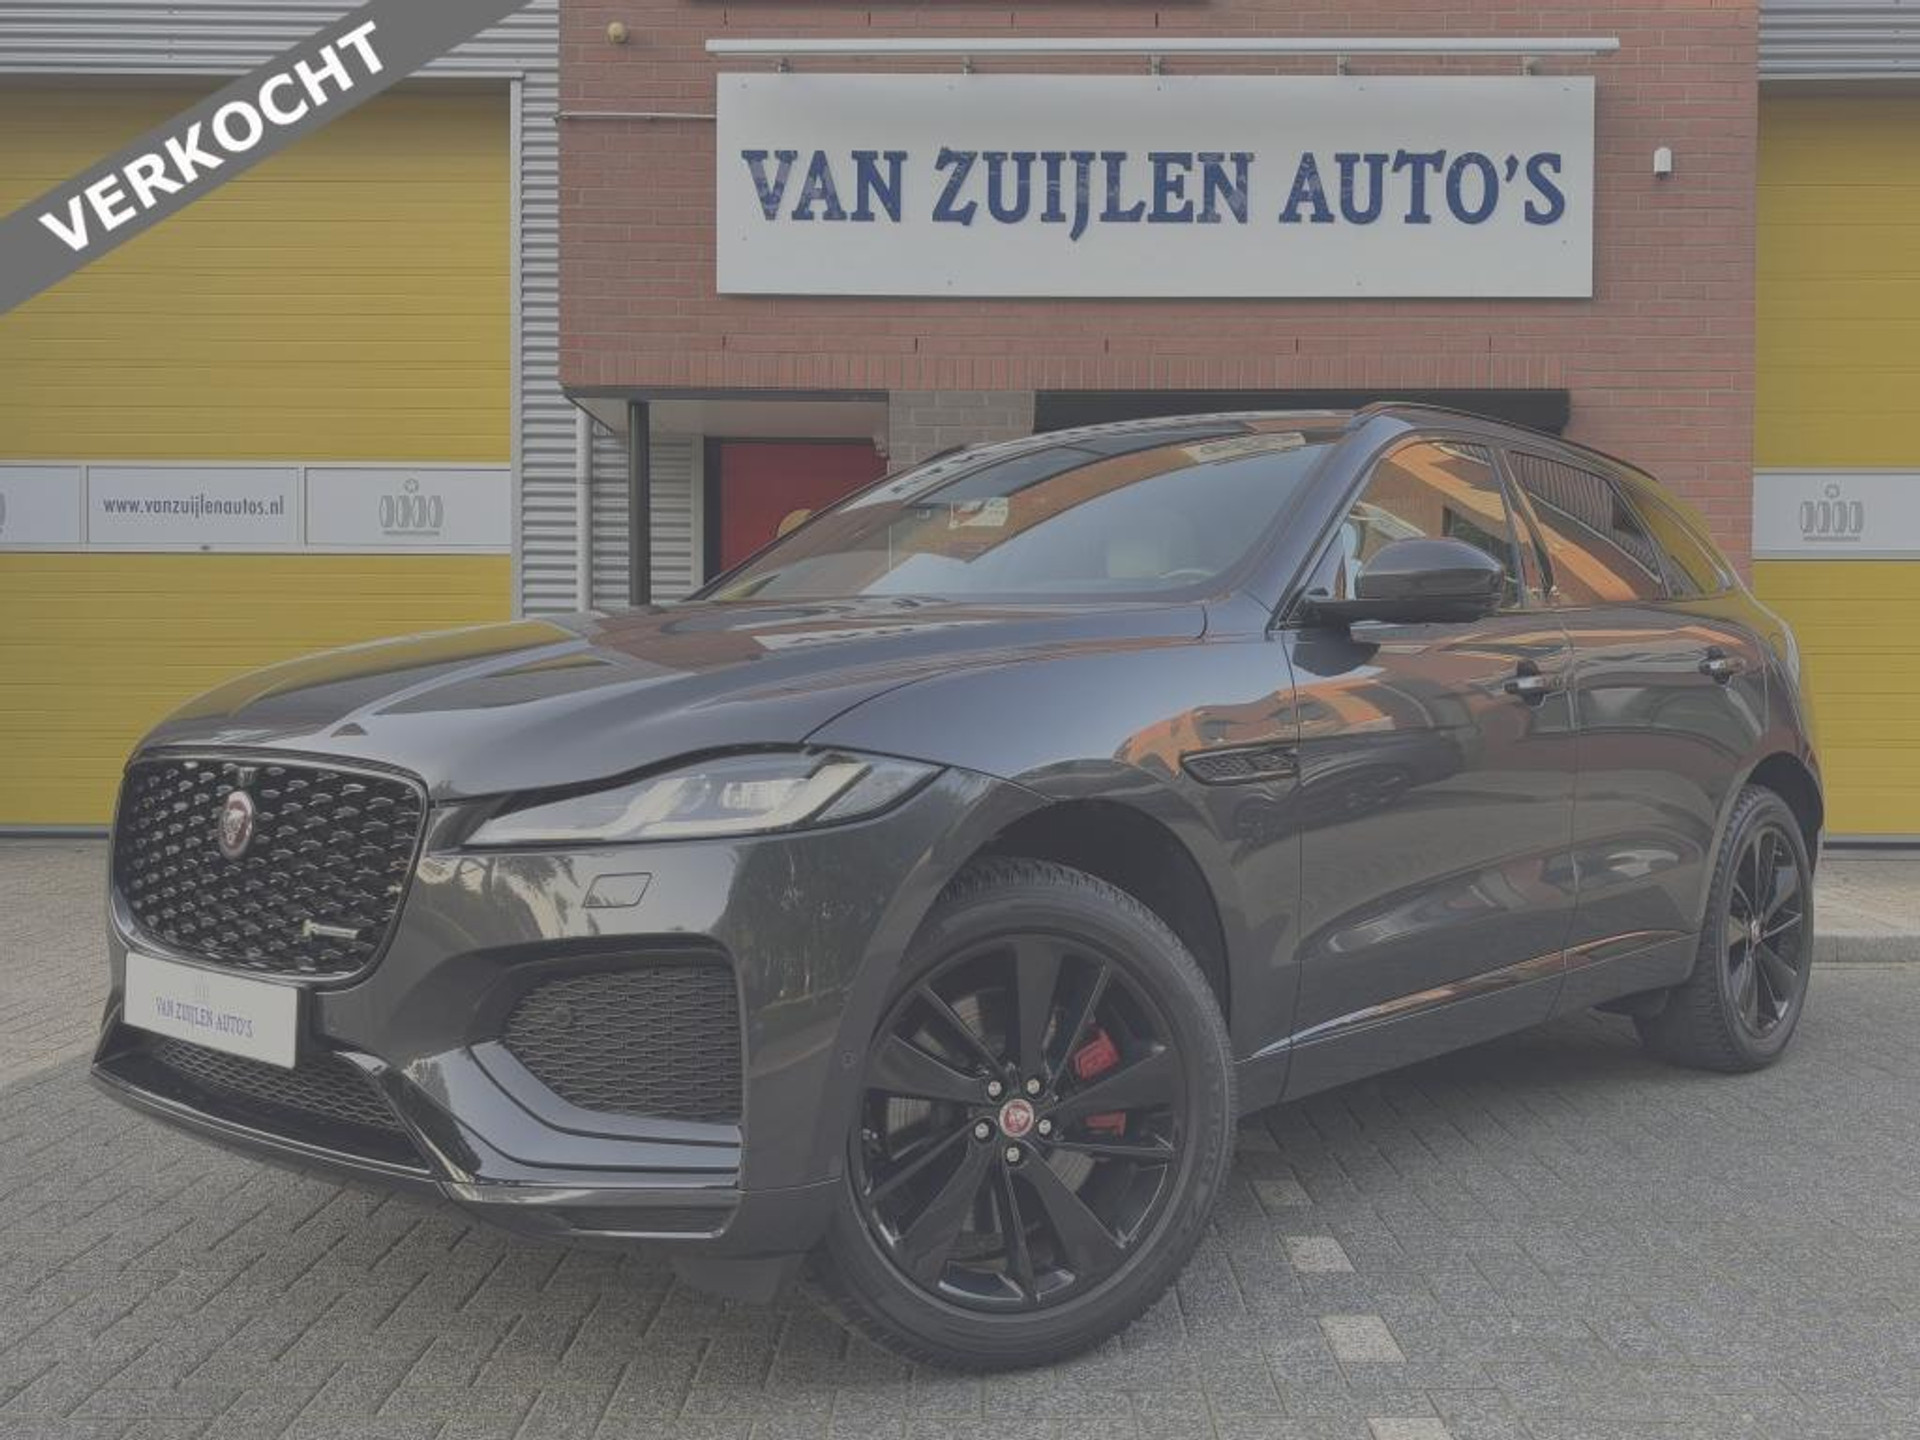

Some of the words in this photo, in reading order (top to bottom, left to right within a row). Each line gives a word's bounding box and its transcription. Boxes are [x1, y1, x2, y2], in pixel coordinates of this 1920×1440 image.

[741, 149, 908, 223] VAN
[932, 146, 1254, 242] ZUIJLEN
[1278, 149, 1567, 227] AUTO'S
[103, 494, 285, 519] www.vanzuijlenautos.nl
[155, 996, 174, 1018] VAN
[214, 1012, 254, 1039] AUTO'S
